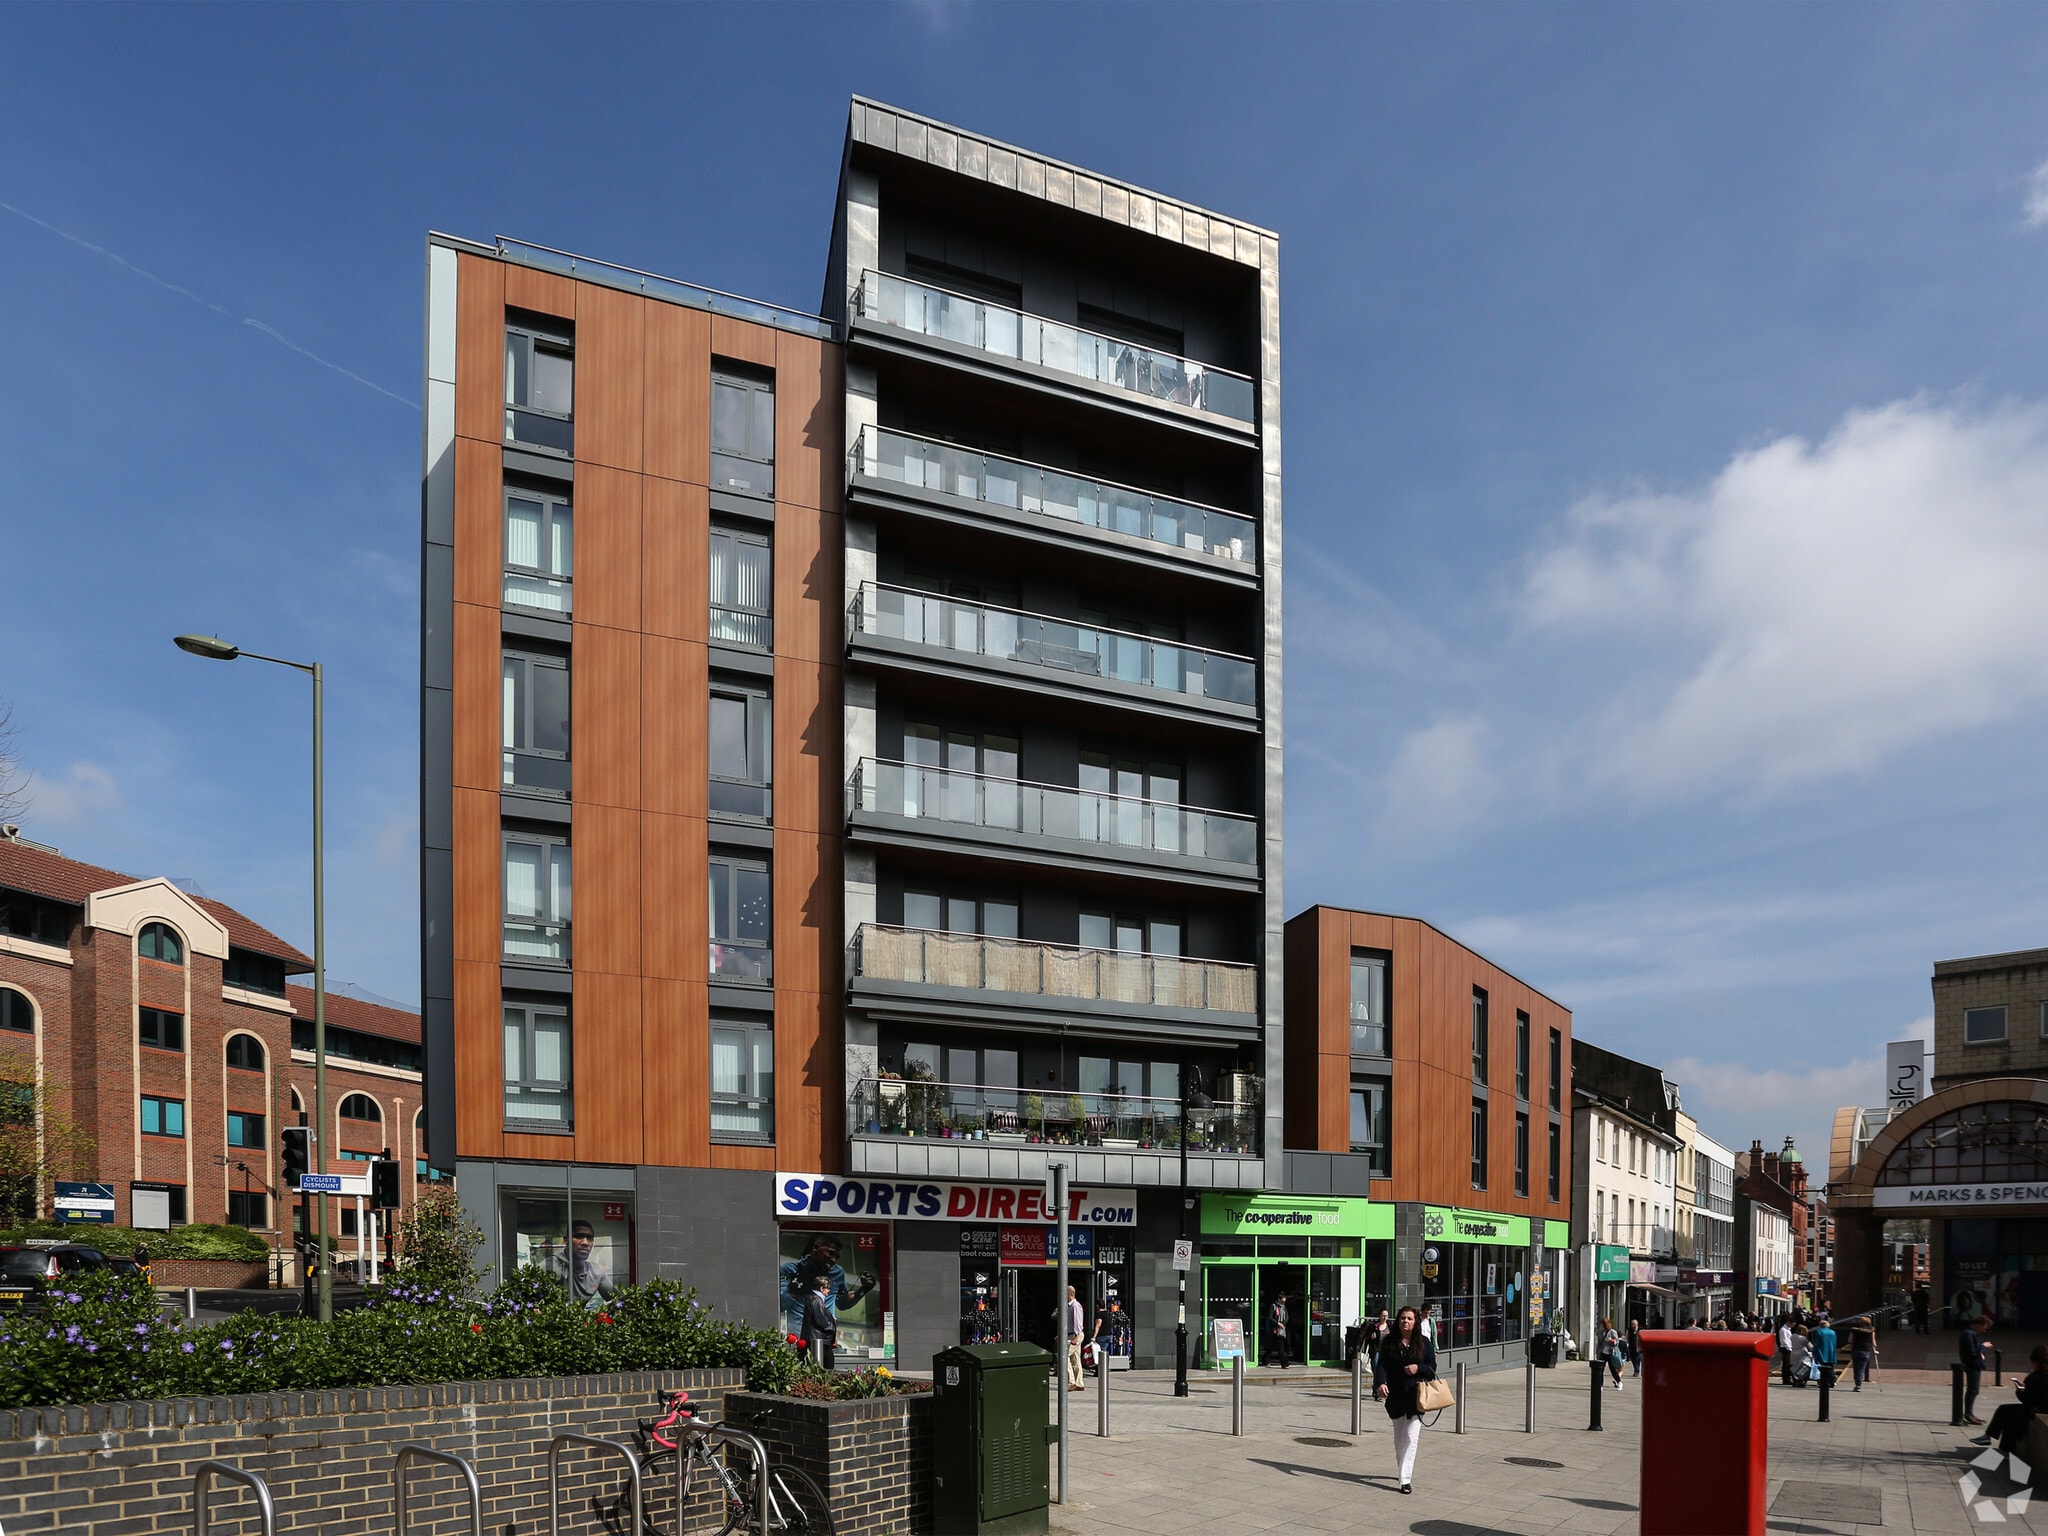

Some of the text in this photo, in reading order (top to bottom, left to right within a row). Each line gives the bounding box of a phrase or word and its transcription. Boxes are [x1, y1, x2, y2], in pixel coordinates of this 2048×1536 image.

[1889, 1065, 1921, 1107] elfry
[781, 1179, 942, 1217] SPORTS
[1910, 1188, 1971, 1202] MARKS
[1975, 1188, 1986, 1200] &
[1225, 1208, 1340, 1226] The co-operative food
[1454, 1218, 1463, 1234] The
[1078, 1235, 1086, 1245] &
[1098, 1251, 1125, 1264] GOLF
[1959, 1262, 1987, 1270] TO LET
